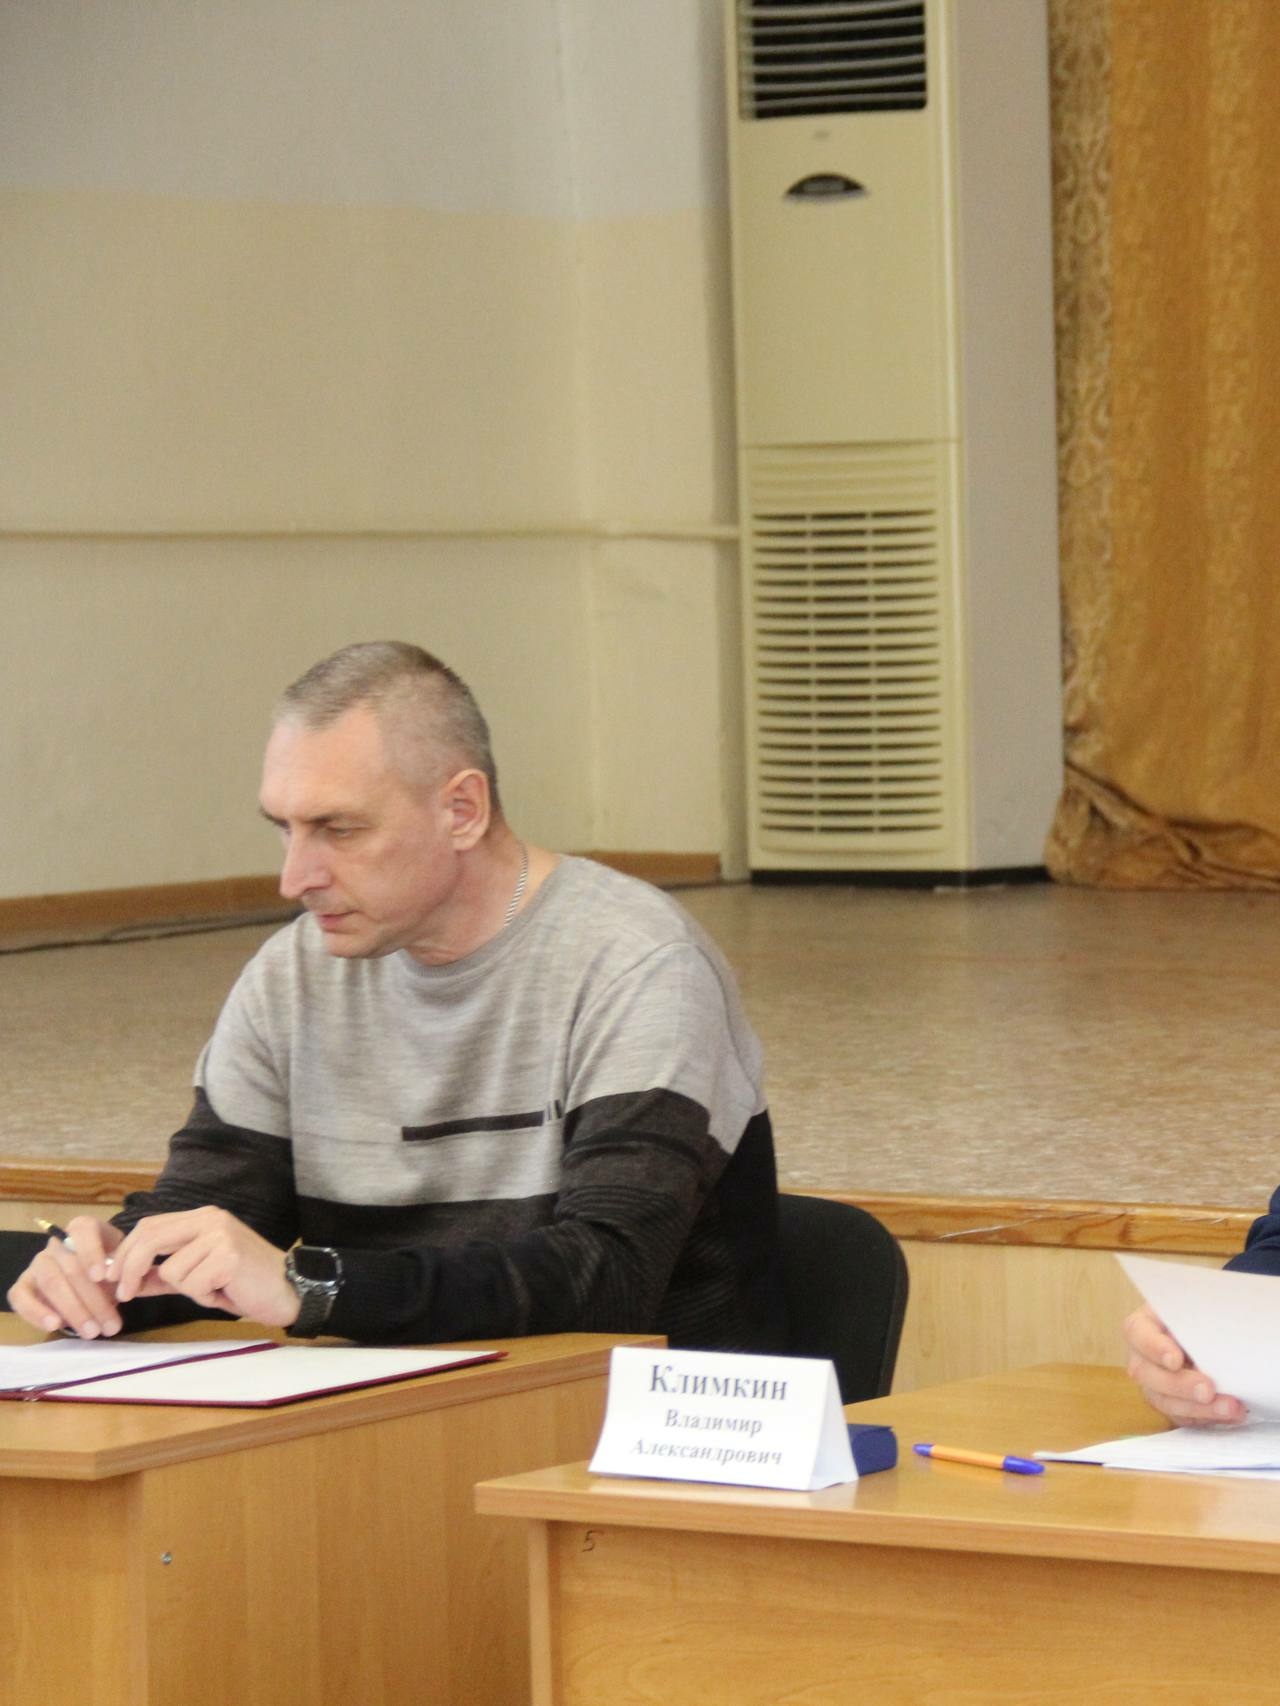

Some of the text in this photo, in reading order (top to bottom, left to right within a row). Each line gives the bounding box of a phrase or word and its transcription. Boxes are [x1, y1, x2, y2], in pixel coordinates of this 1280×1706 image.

[649, 1364, 788, 1401] Климкин
[664, 1408, 763, 1438] Владимир
[631, 1438, 783, 1466] Александрович
